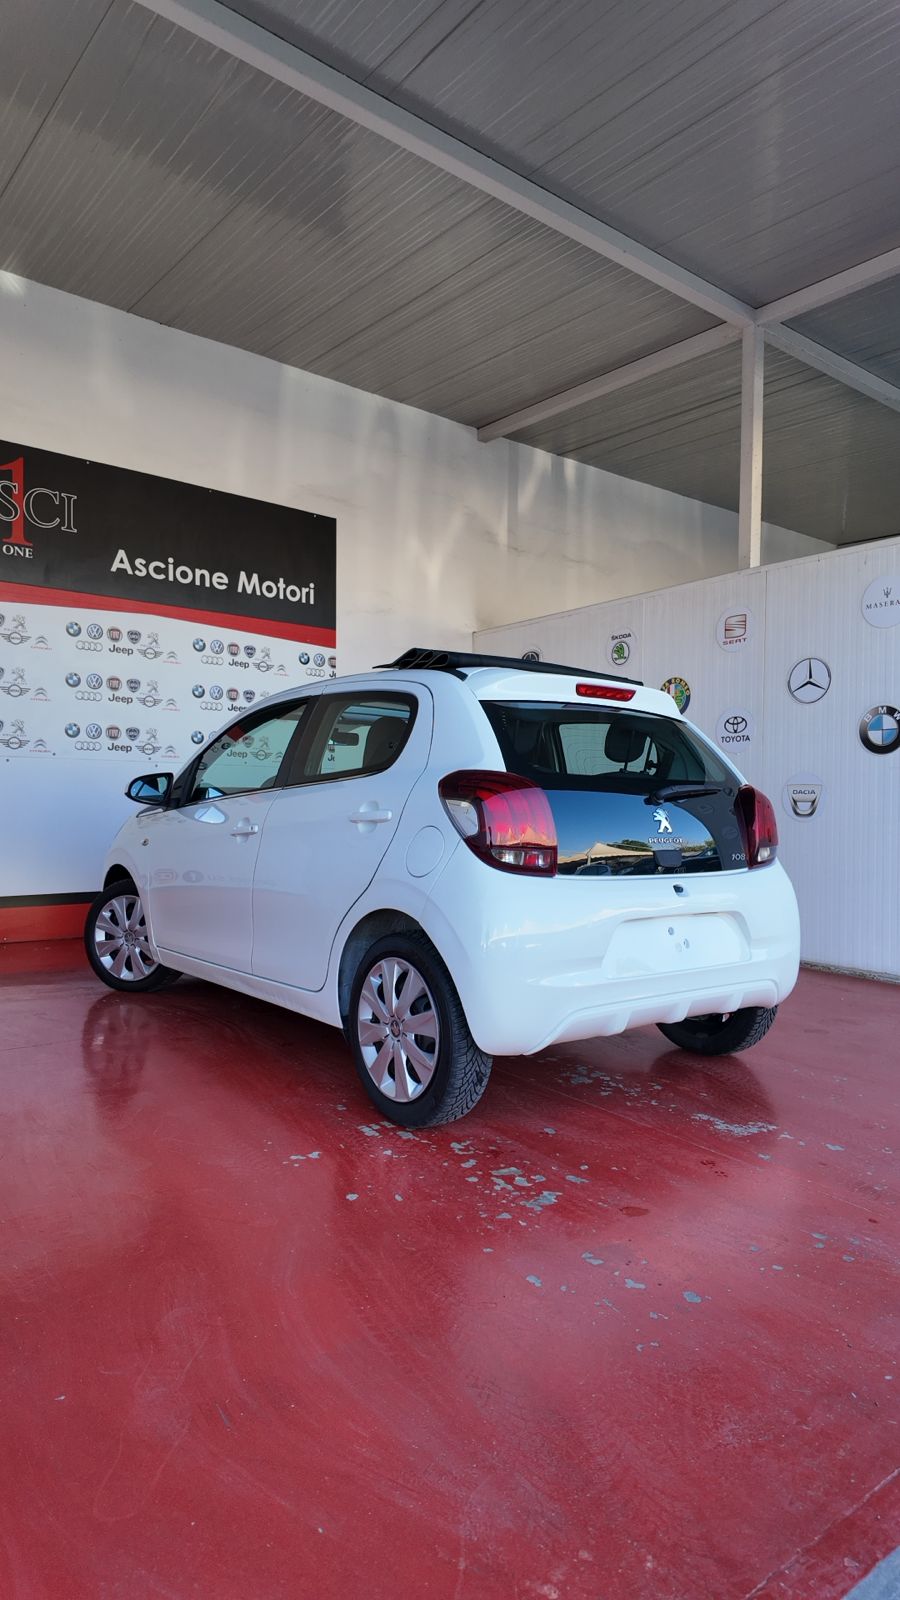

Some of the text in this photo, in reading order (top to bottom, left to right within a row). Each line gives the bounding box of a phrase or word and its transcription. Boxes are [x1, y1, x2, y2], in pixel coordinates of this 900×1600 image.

[2, 544, 33, 559] ONE
[110, 549, 315, 605] Ascione Motori
[722, 637, 747, 645] SEAT
[108, 644, 134, 656] Jeep
[228, 658, 250, 669] Jeep
[108, 693, 133, 704] Jeep
[720, 735, 750, 743] TOYOTA
[107, 743, 132, 753] Jeep
[227, 749, 248, 759] Jeep
